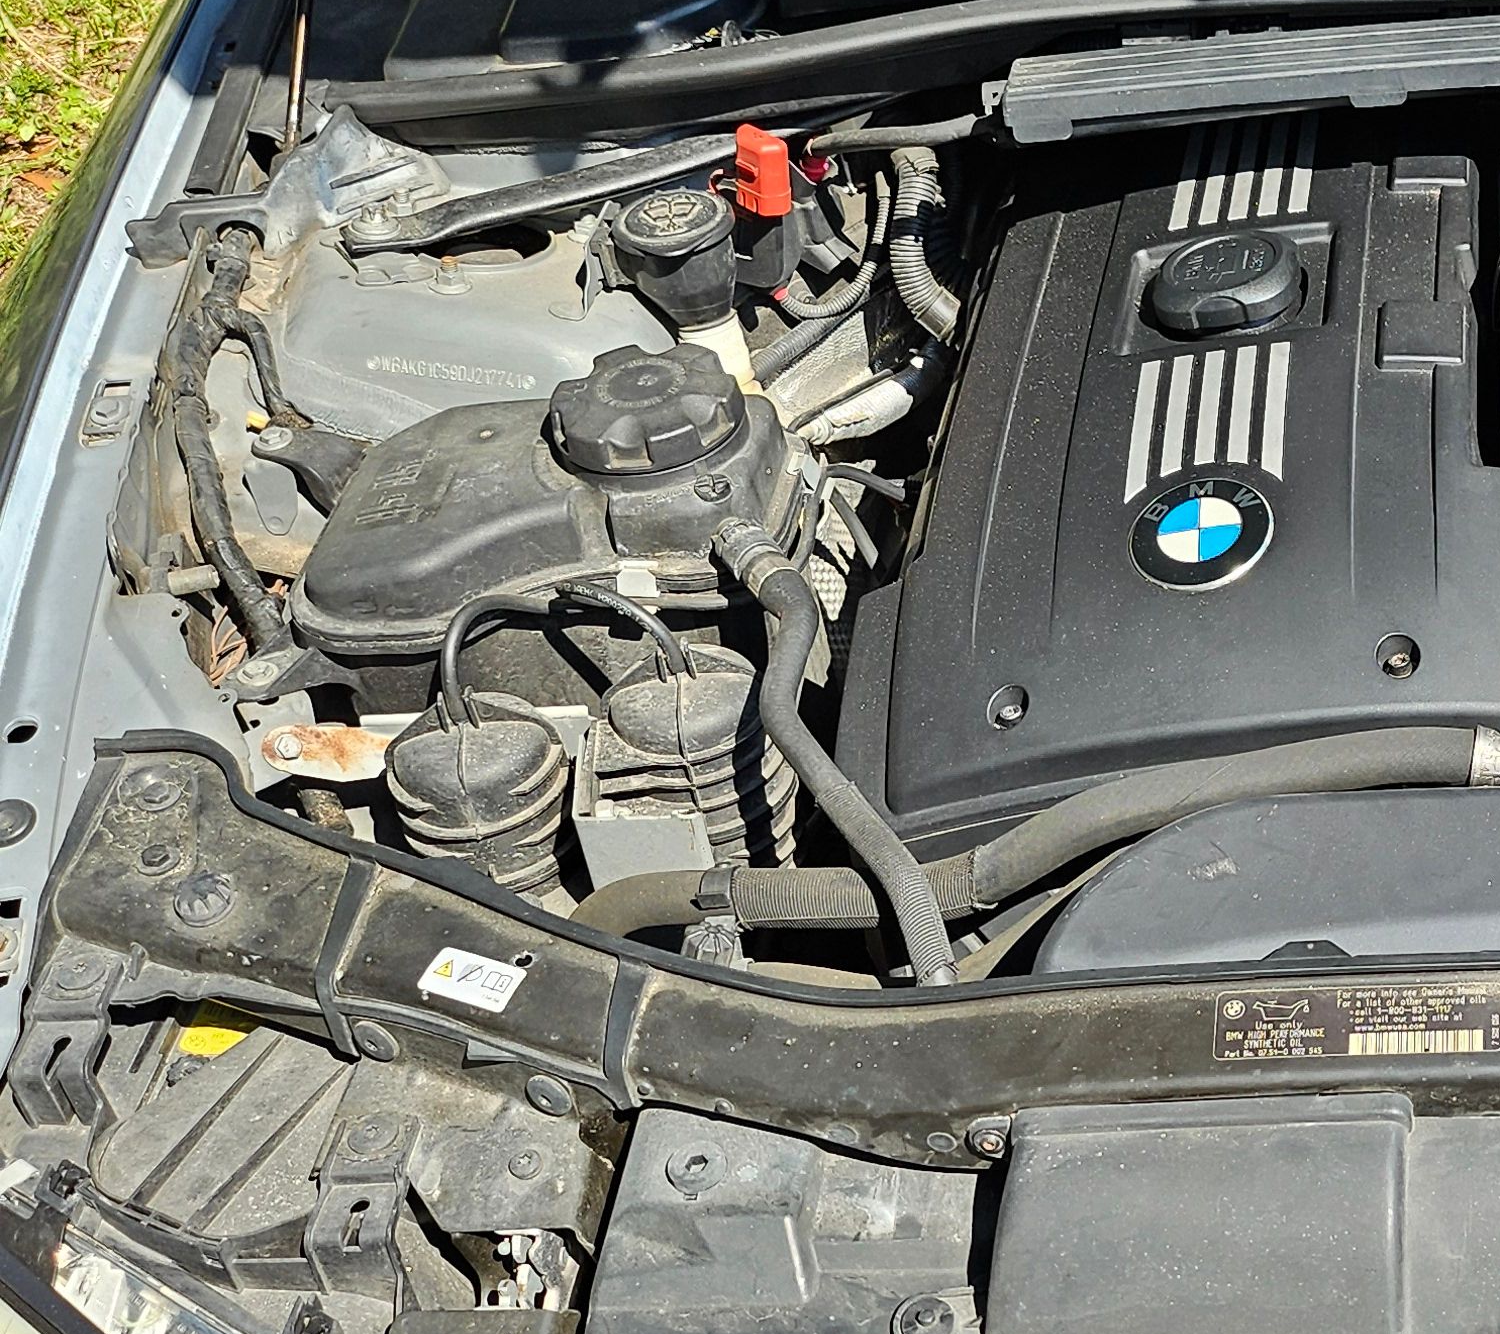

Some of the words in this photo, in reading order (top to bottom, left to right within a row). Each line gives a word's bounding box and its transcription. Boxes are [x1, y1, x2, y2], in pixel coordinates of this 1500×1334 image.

[1144, 481, 1261, 522] BMW
[1337, 990, 1352, 999] For
[1421, 987, 1453, 996] Owner's
[1337, 999, 1351, 1008] For
[1366, 997, 1381, 1007] list
[1386, 998, 1396, 1006] of
[1400, 996, 1422, 1006] other
[1427, 995, 1466, 1006] approved
[1469, 995, 1487, 1004] oils
[1369, 1014, 1389, 1023] visit
[1393, 1015, 1407, 1023] our
[1411, 1013, 1428, 1022] web
[1432, 1013, 1449, 1021] site
[1255, 1021, 1274, 1029] Use
[1279, 1020, 1303, 1031] only
[1226, 1031, 1244, 1041] BMW
[1247, 1030, 1266, 1039] HIGH
[1270, 1028, 1325, 1038] PERFORMANCE
[1243, 1038, 1286, 1049] SYNTHETIC
[1290, 1038, 1304, 1047] OIL
